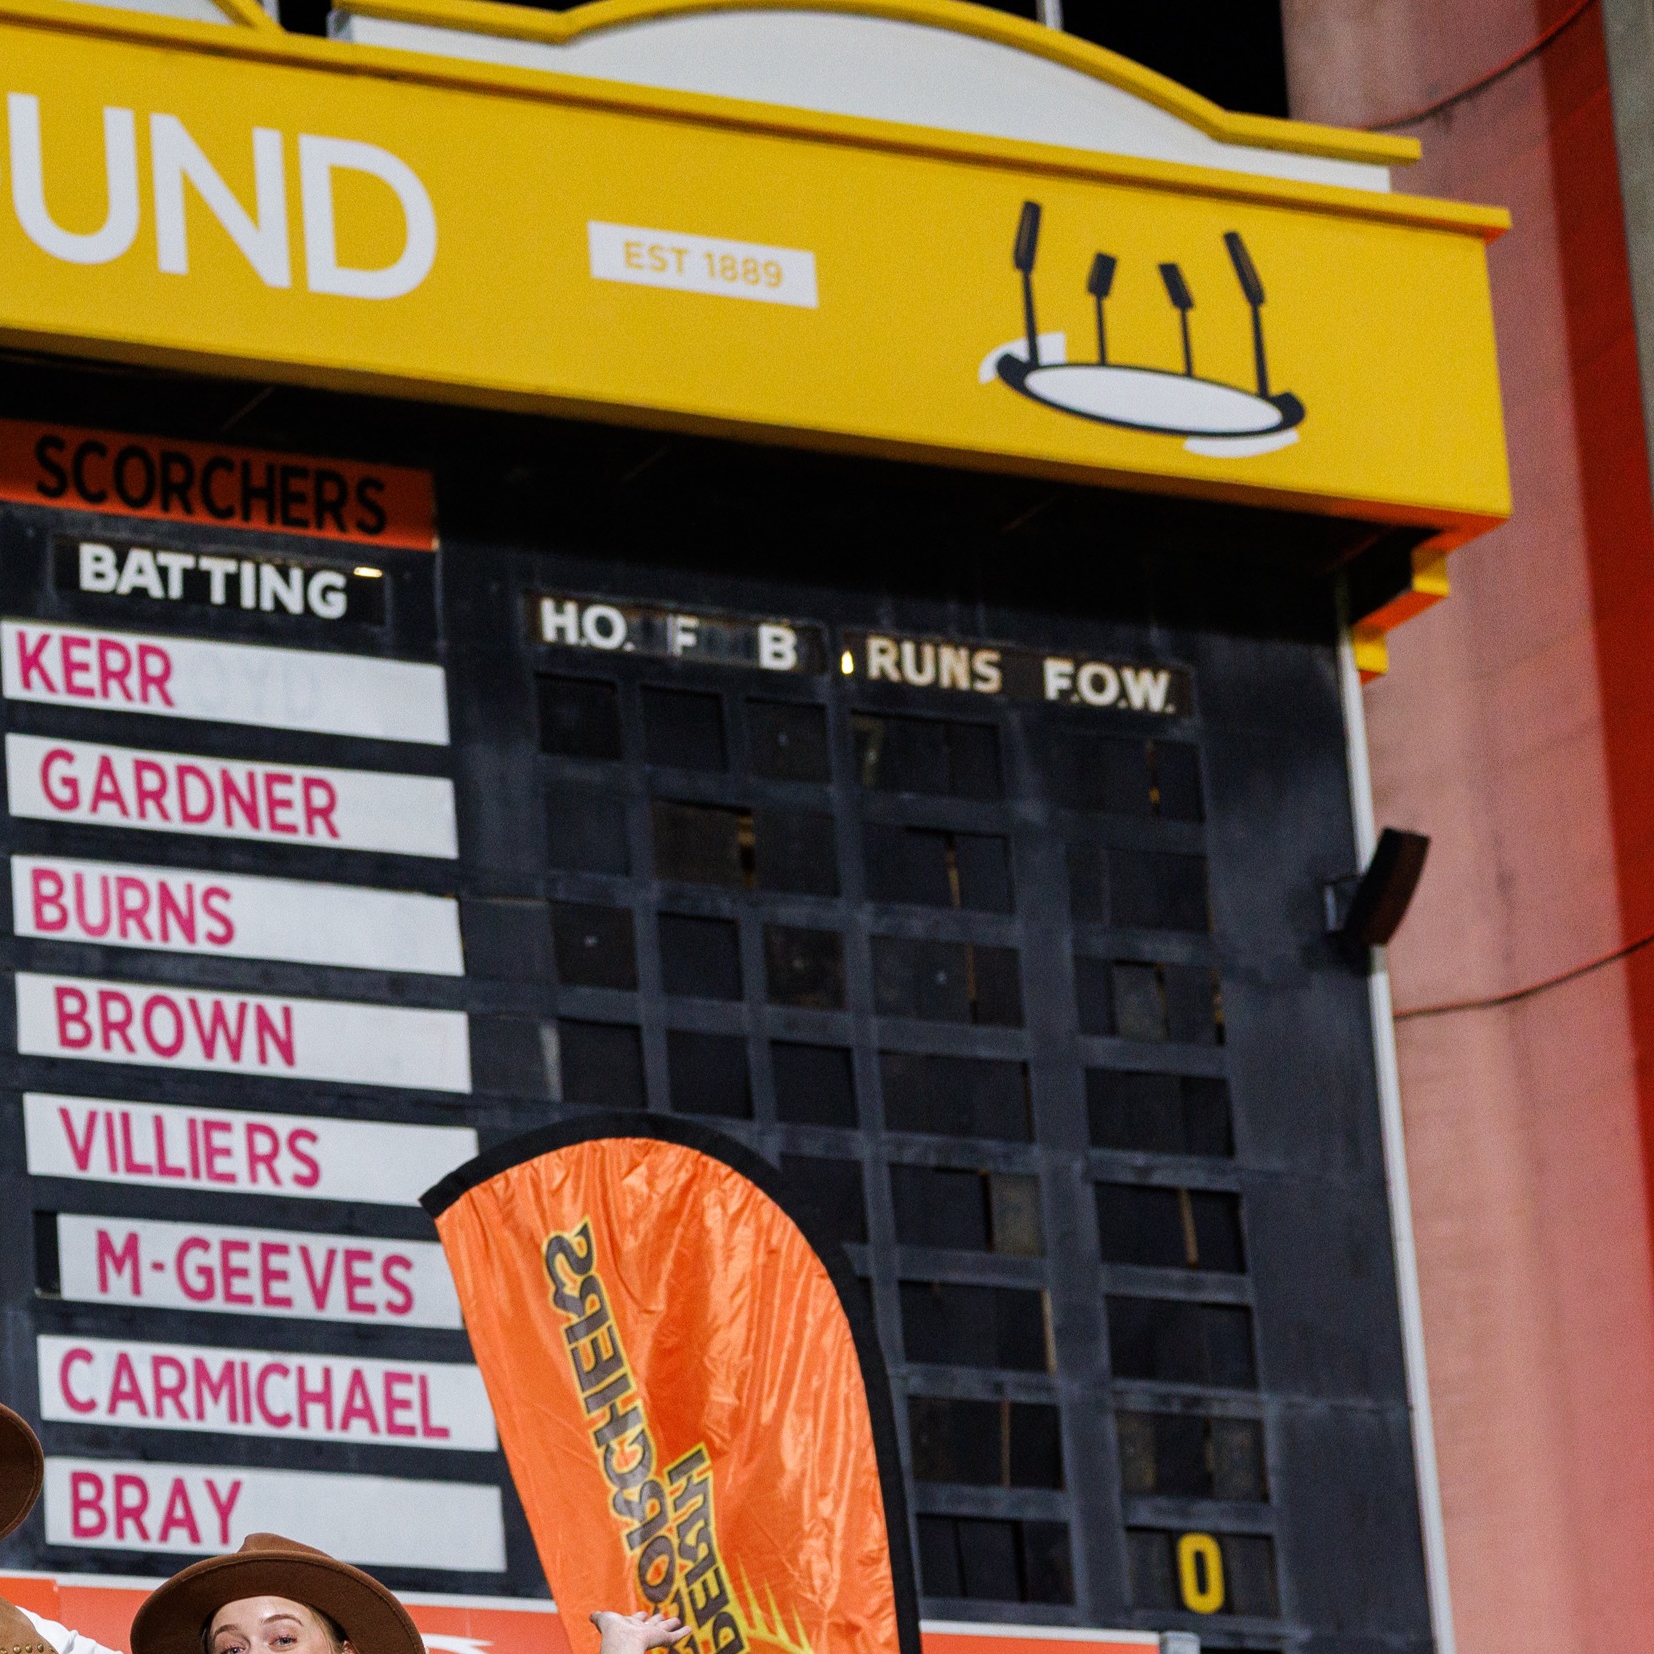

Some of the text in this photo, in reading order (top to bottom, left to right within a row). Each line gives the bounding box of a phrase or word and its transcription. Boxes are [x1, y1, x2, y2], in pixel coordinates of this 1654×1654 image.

[623, 241, 783, 289] EST 1889
[35, 434, 388, 538] SCORCHERS
[79, 541, 348, 620] BATTING
[16, 630, 175, 708] KERR
[758, 624, 798, 671] B
[866, 635, 1003, 694] RUNS
[39, 748, 340, 841] GARDNER
[31, 868, 235, 947] BURNS
[56, 986, 296, 1069] BROWN
[58, 1106, 320, 1190] VILLIERS
[60, 1347, 450, 1439] CARMICHAEL
[70, 1470, 243, 1545] BRAY
[1176, 1532, 1225, 1615] 0
